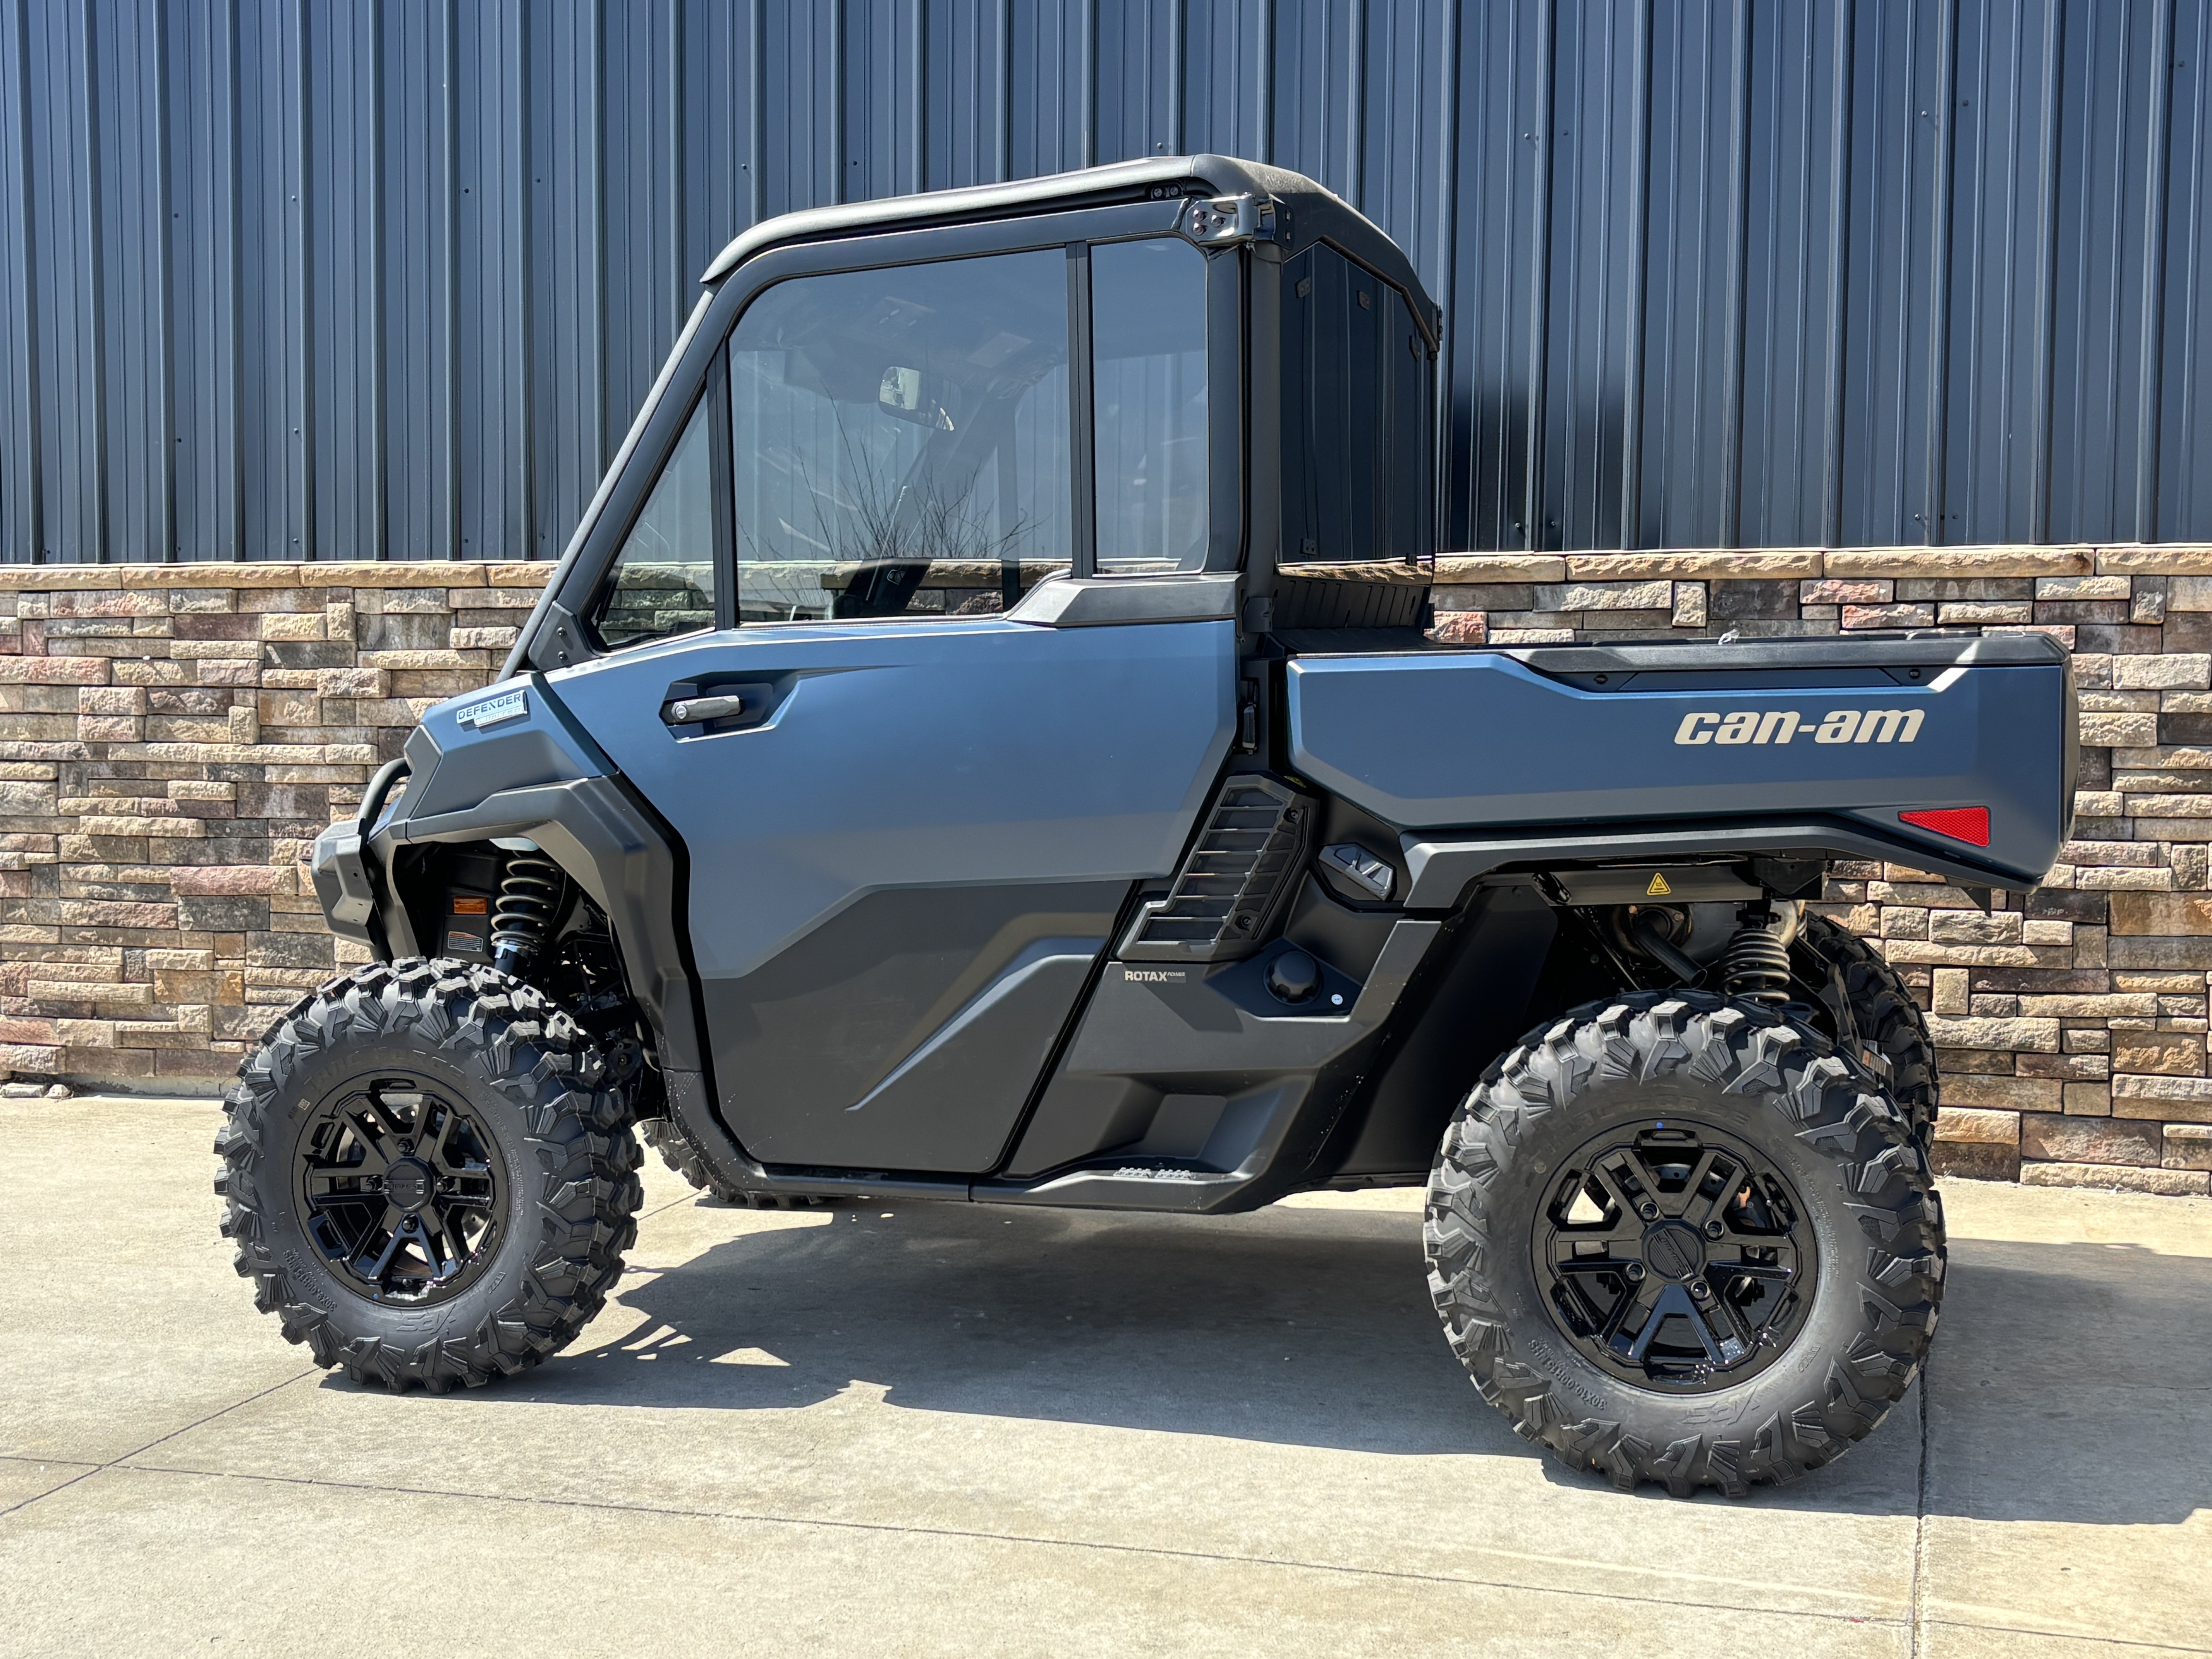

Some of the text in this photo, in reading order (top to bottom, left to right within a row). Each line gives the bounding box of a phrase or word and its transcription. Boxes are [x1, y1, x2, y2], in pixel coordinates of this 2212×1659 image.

[459, 693, 521, 720] DEFENDER
[1674, 709, 1925, 745] can-am
[1125, 970, 1168, 982] ROTAX
[1528, 1340, 1551, 1363] NHS
